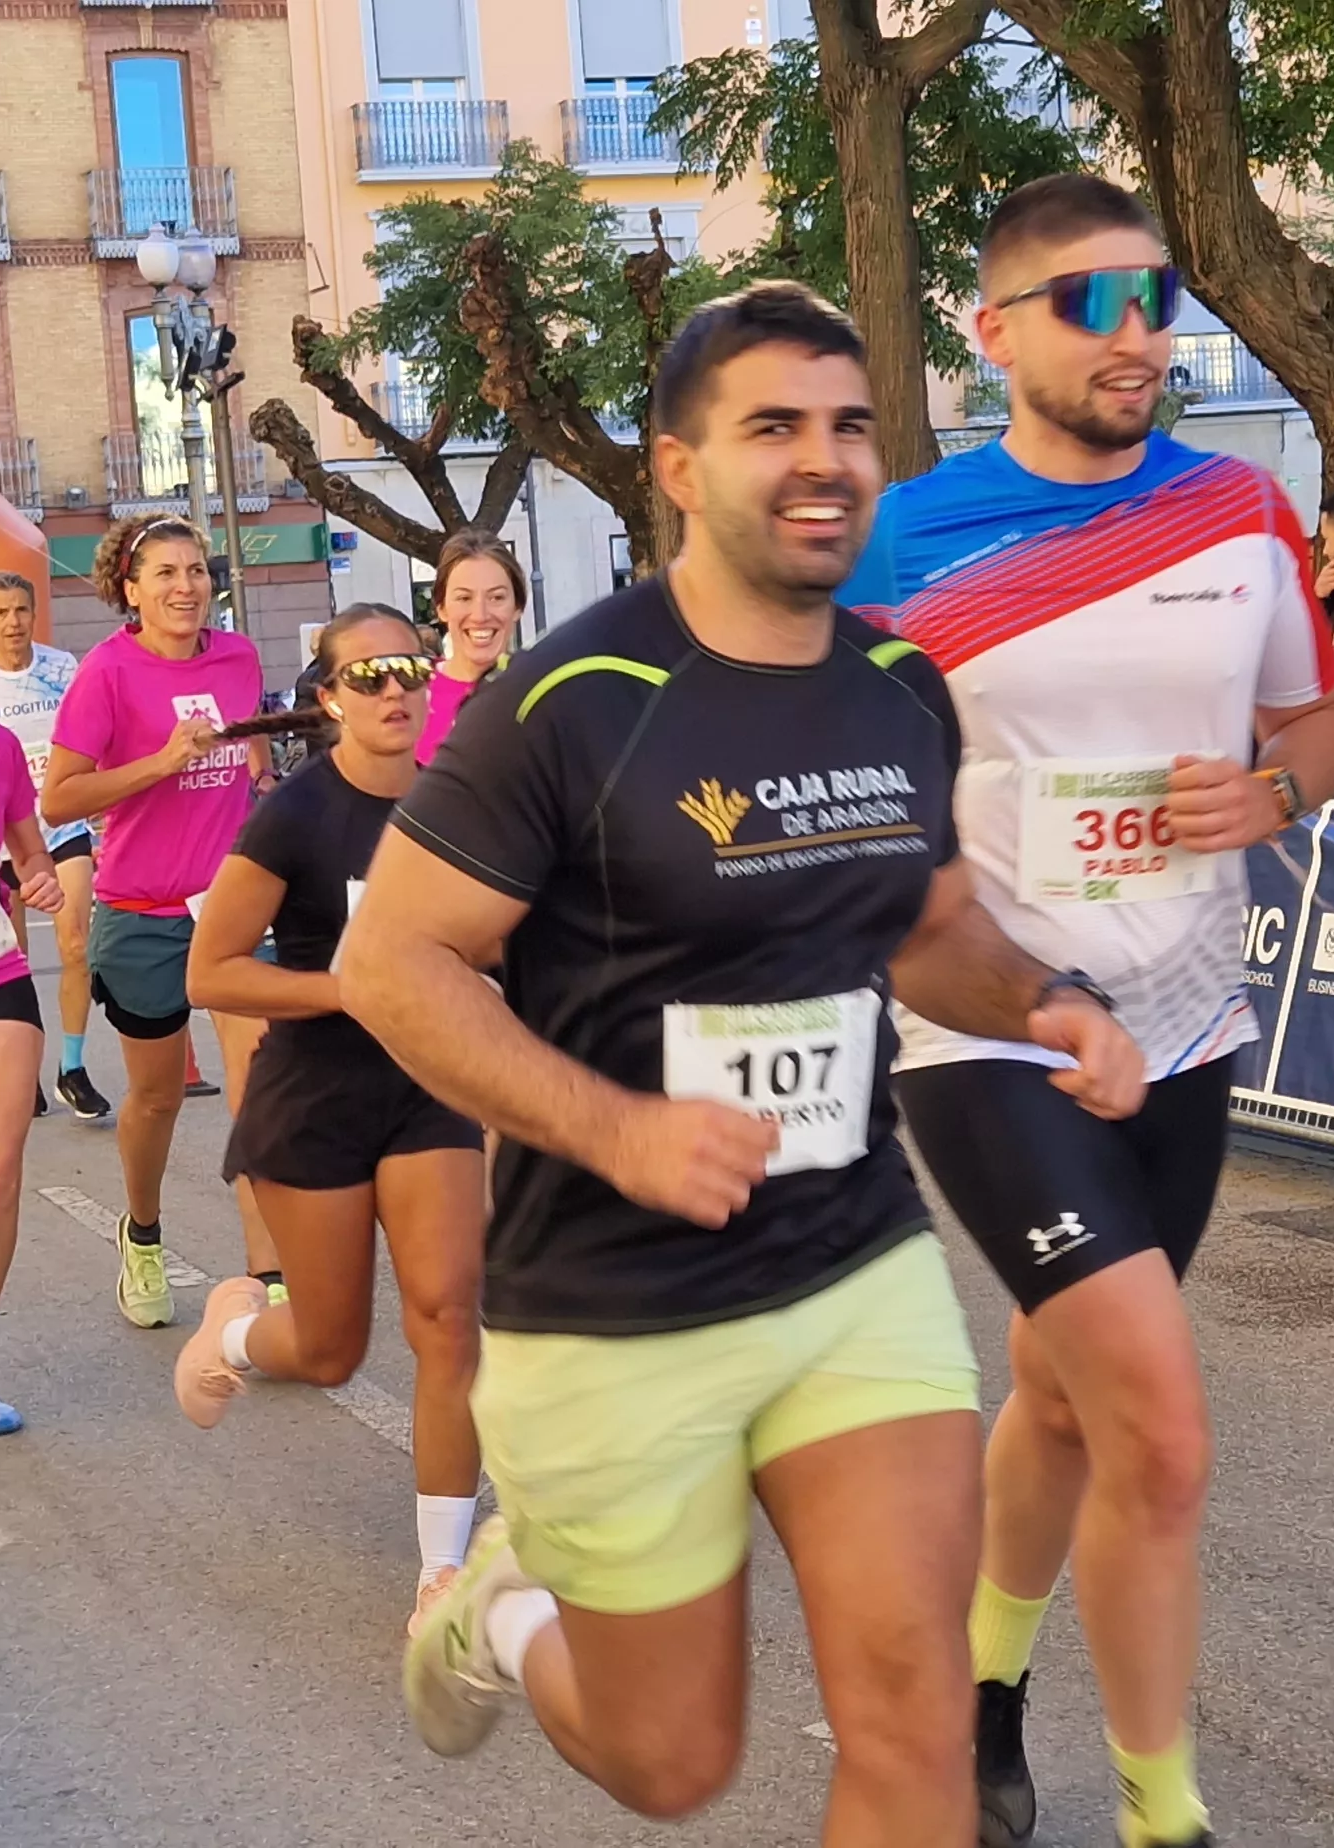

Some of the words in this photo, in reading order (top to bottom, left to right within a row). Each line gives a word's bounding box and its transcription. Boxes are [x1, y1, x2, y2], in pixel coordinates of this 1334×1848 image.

[27, 755, 48, 771] 12
[755, 773, 831, 811] CAJA
[827, 764, 917, 801] RURAL
[781, 811, 815, 837] DE
[1073, 804, 1176, 851] 366
[1083, 855, 1168, 877] PABLO
[1242, 905, 1285, 965] IC
[725, 1043, 841, 1098] 107
